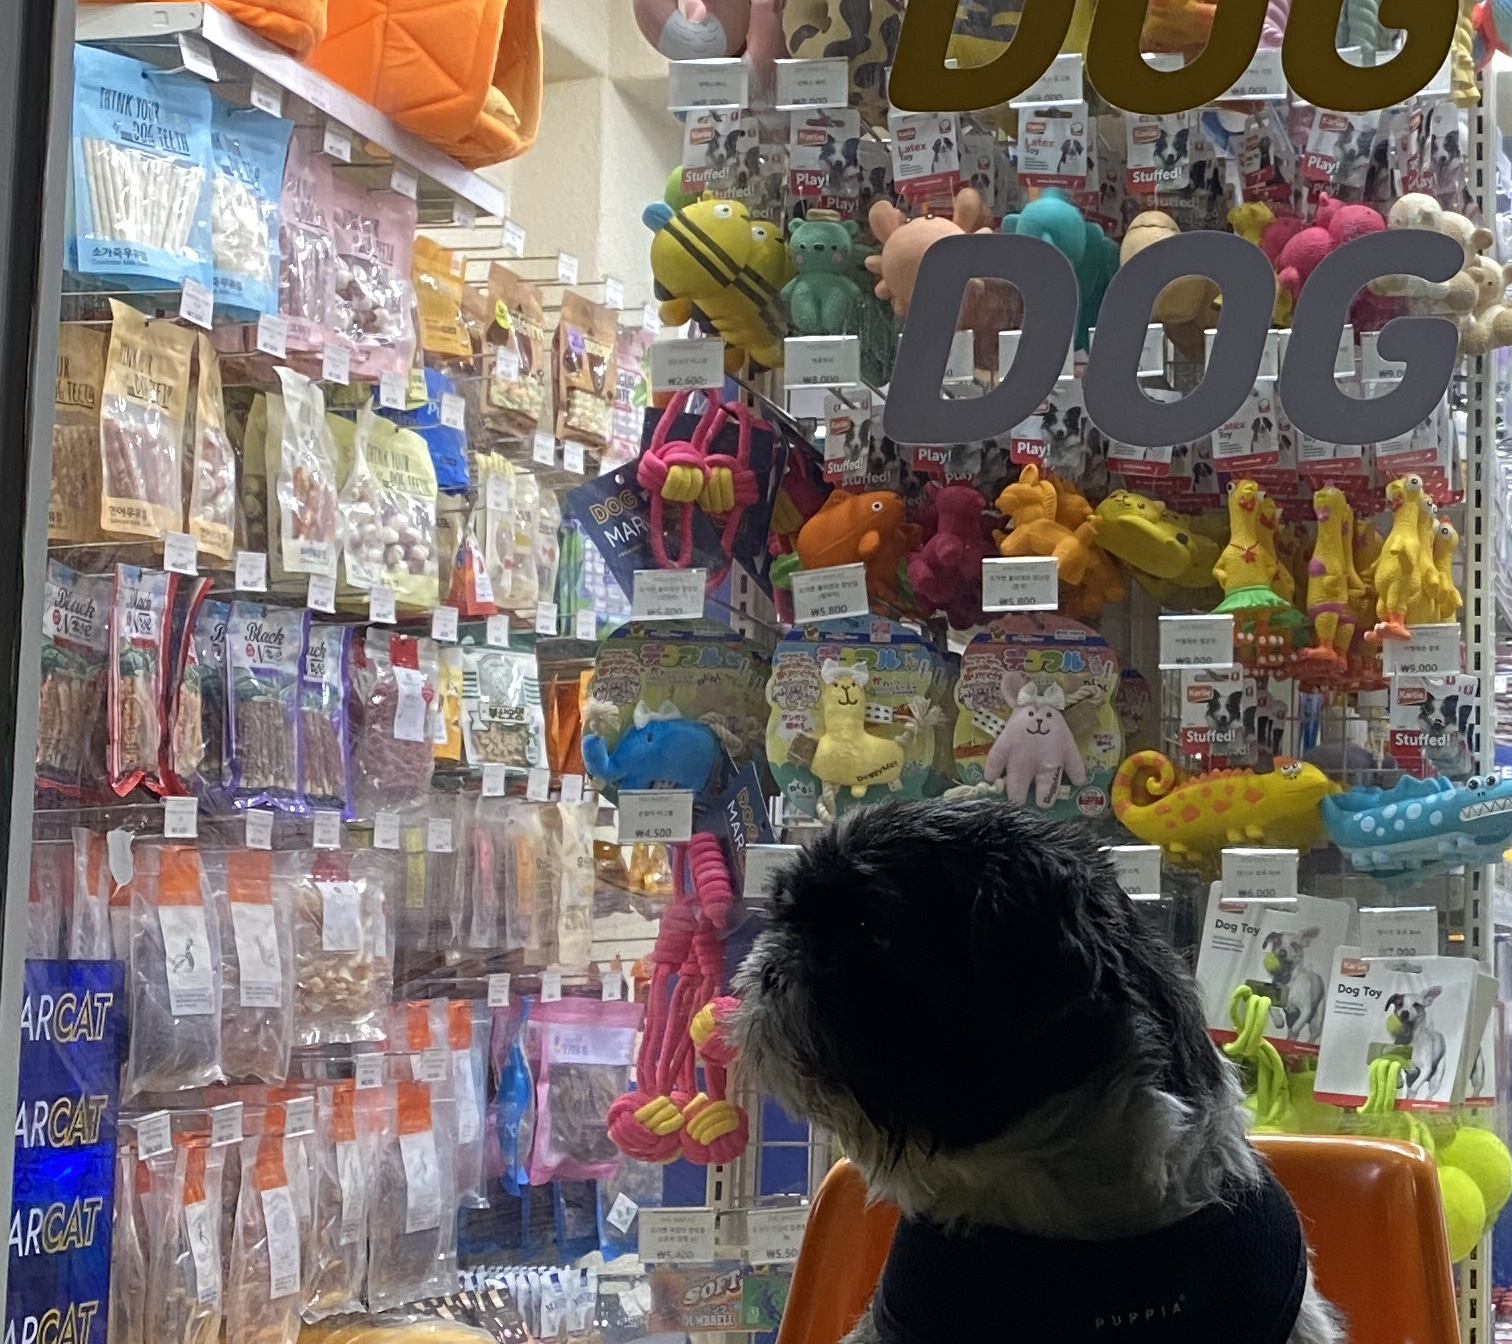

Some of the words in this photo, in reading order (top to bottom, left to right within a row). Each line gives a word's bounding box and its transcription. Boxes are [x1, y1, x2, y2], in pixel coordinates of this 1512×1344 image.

[1308, 155, 1340, 174] Play!
[684, 167, 730, 184] Stuffed!
[795, 172, 830, 189] Play!
[1132, 166, 1182, 184] Stuffed!
[881, 229, 1465, 447] DOG
[918, 449, 951, 464] Play!
[1017, 442, 1050, 458] Play!
[827, 457, 864, 474] Stuffed!
[589, 488, 639, 526] DOG
[245, 622, 285, 645] Black
[1186, 729, 1236, 744] Stuffed!
[1395, 732, 1450, 748] Stuffed!
[1214, 919, 1238, 934] Dog
[1241, 921, 1261, 937] Toy
[1337, 983, 1360, 998] Dog
[1362, 985, 1383, 1001] Toy
[766, 1248, 799, 1259] ₩5,50
[683, 1267, 742, 1305] SOFT
[1095, 1300, 1182, 1330] PUPPIA
